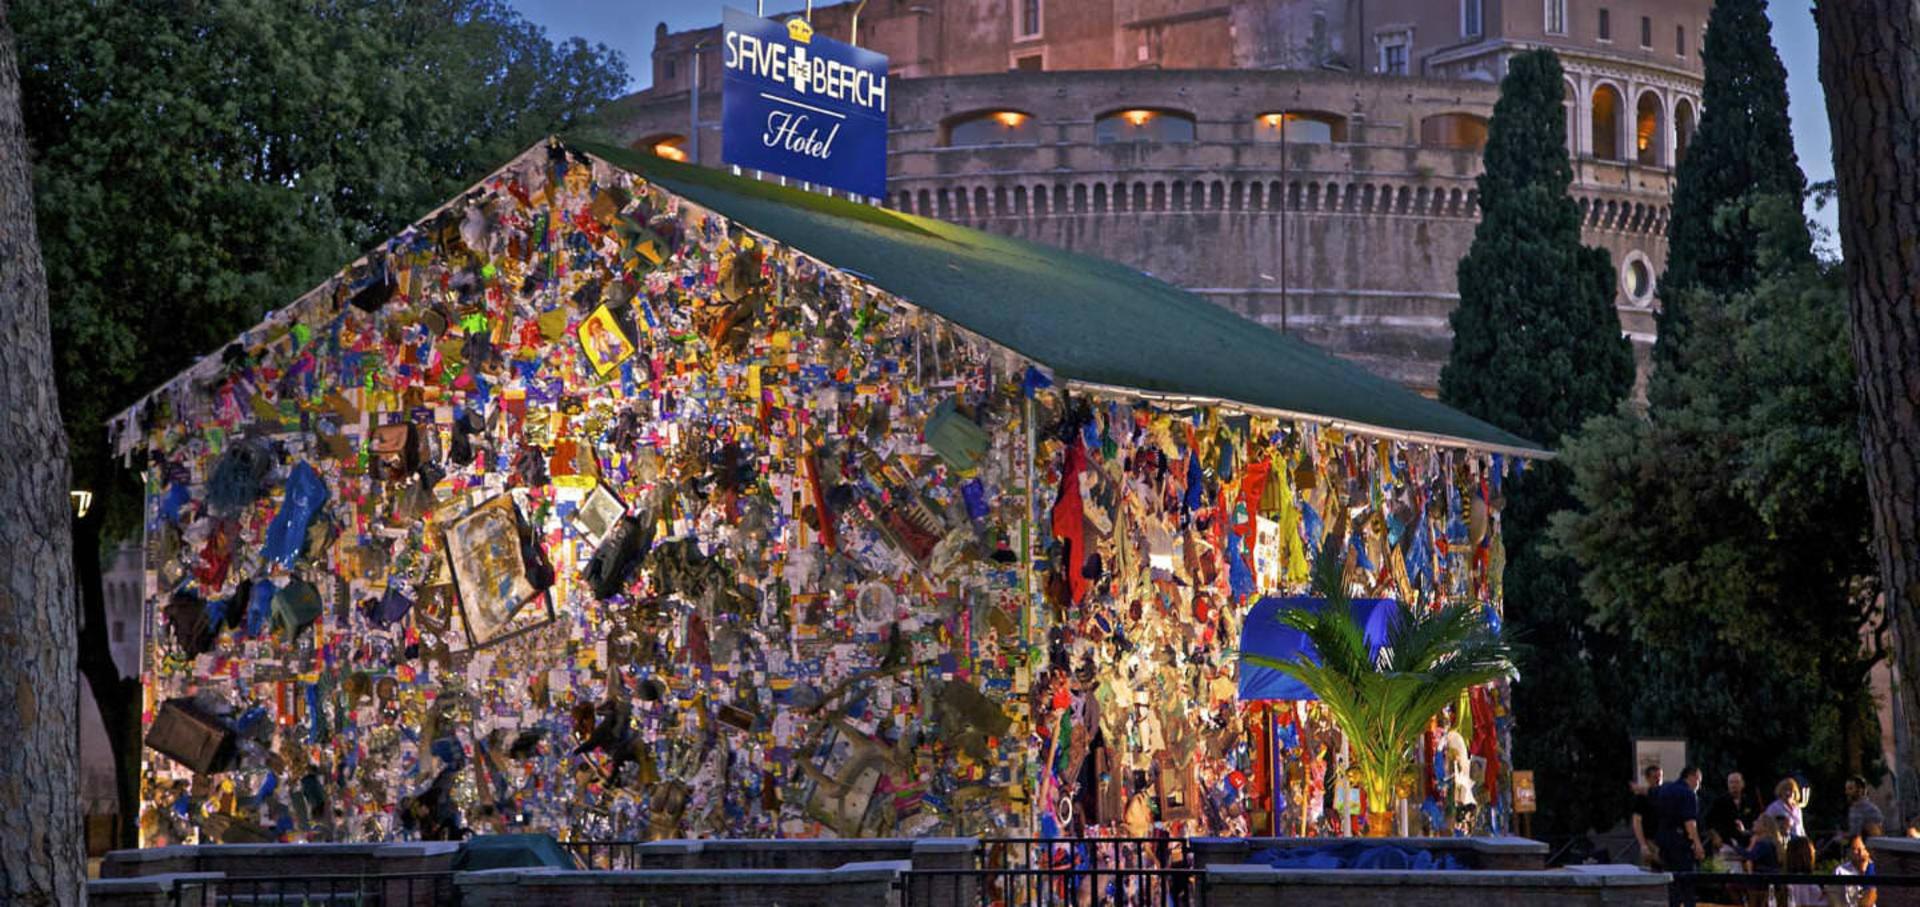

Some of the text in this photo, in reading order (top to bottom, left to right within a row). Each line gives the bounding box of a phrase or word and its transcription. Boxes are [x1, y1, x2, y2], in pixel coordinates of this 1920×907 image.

[725, 31, 887, 113] SAVE THE BEACH
[763, 110, 840, 160] Hotel
